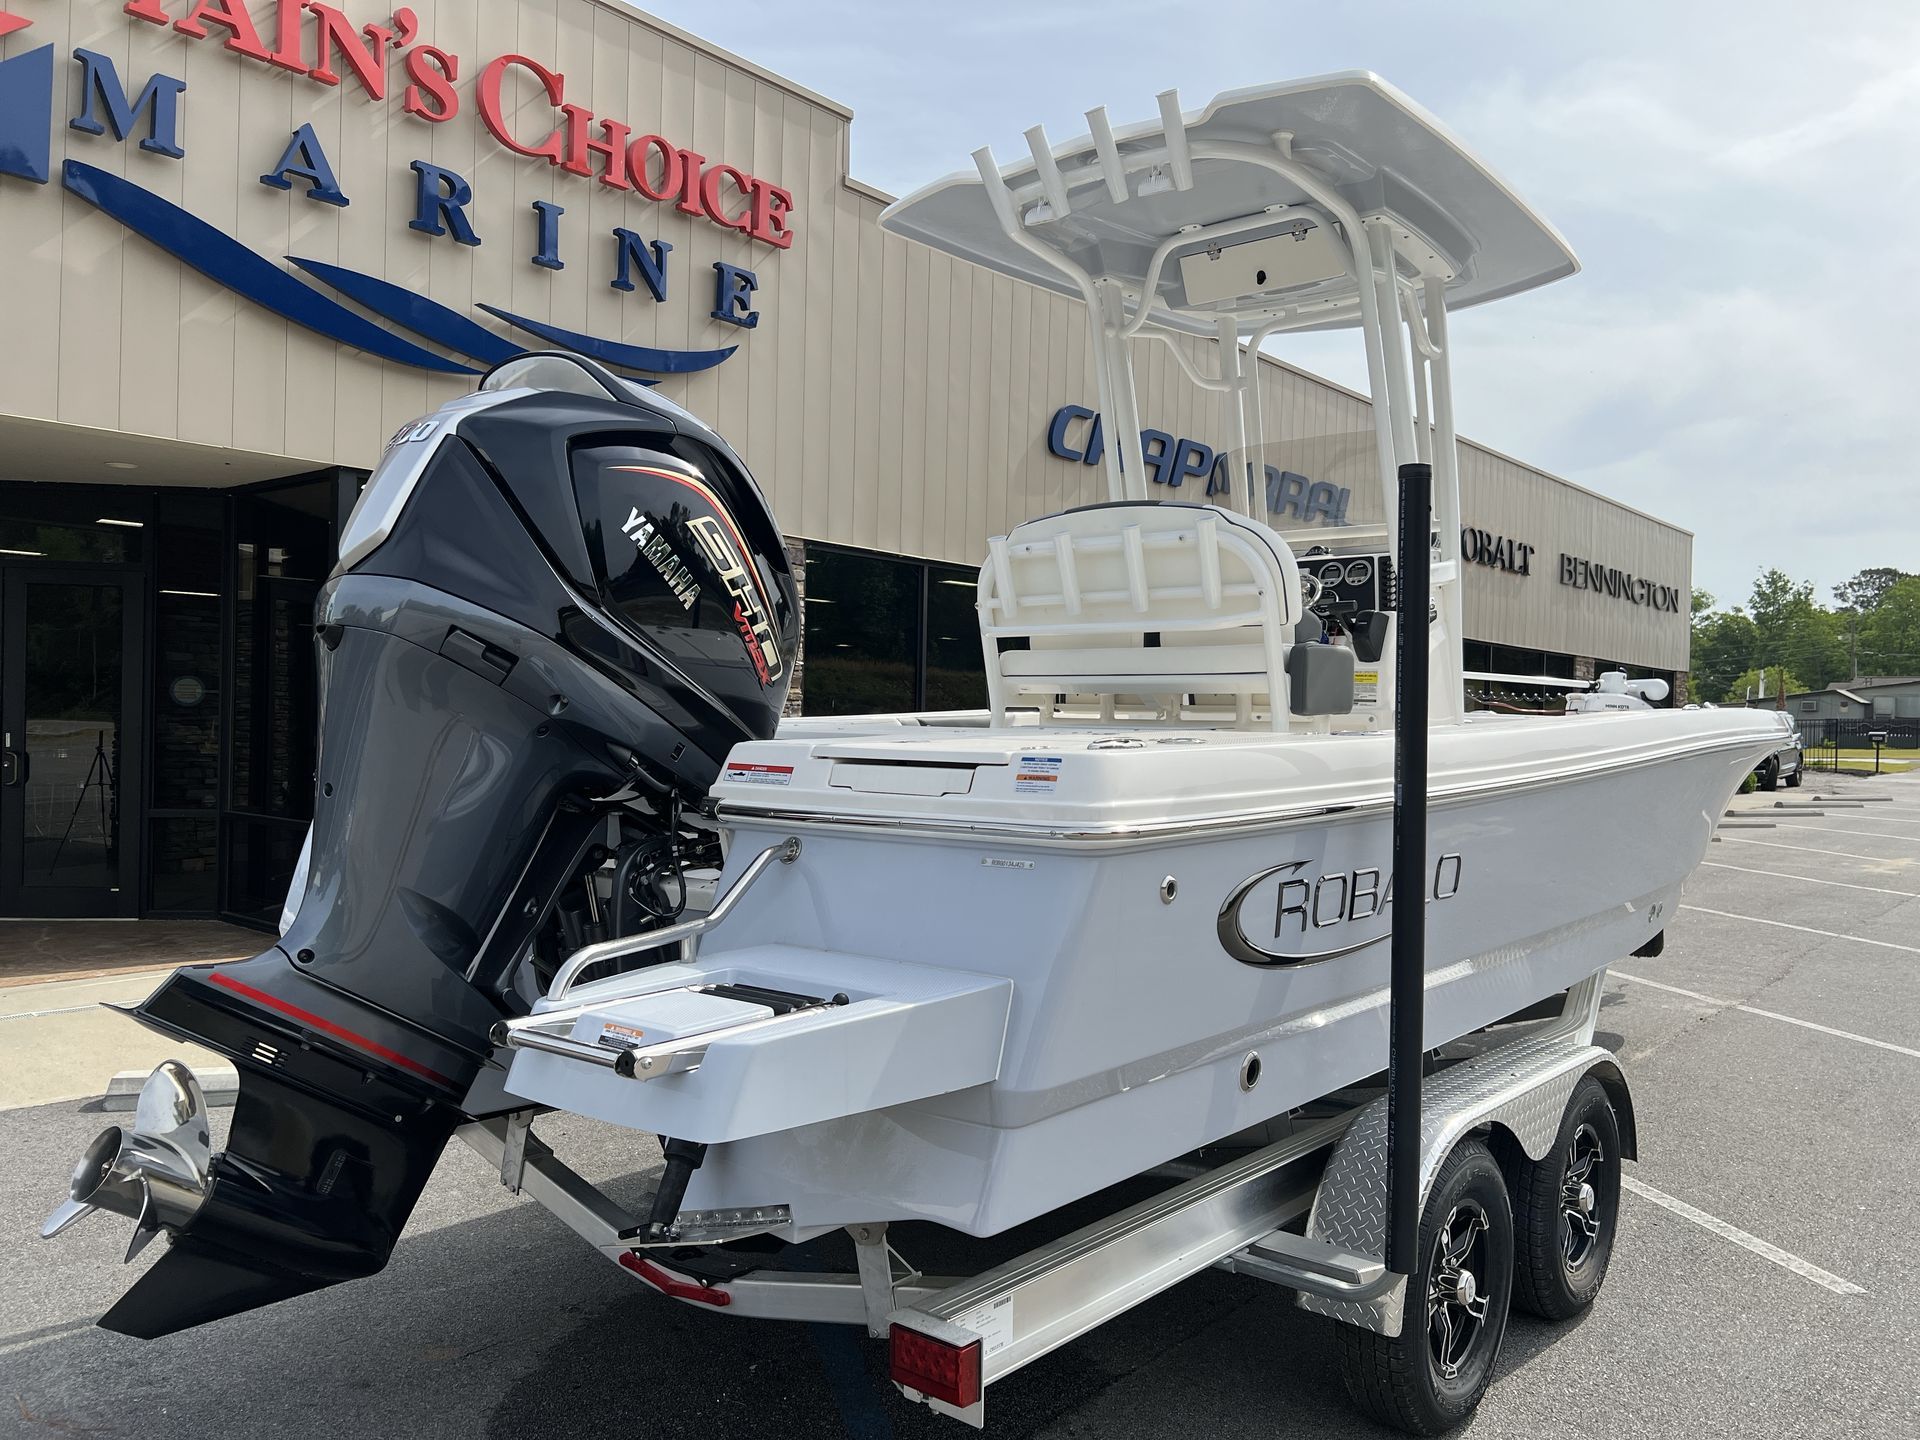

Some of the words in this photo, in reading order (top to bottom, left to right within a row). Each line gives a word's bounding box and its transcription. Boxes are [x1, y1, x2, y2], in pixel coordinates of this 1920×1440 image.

[123, 0, 460, 122] AIN'S
[477, 54, 795, 250] CHOICE
[67, 46, 761, 330] MARINE
[621, 506, 702, 611] YAMAHA
[1460, 524, 1536, 577] OBALT
[1560, 552, 1680, 614] BENNINGTON
